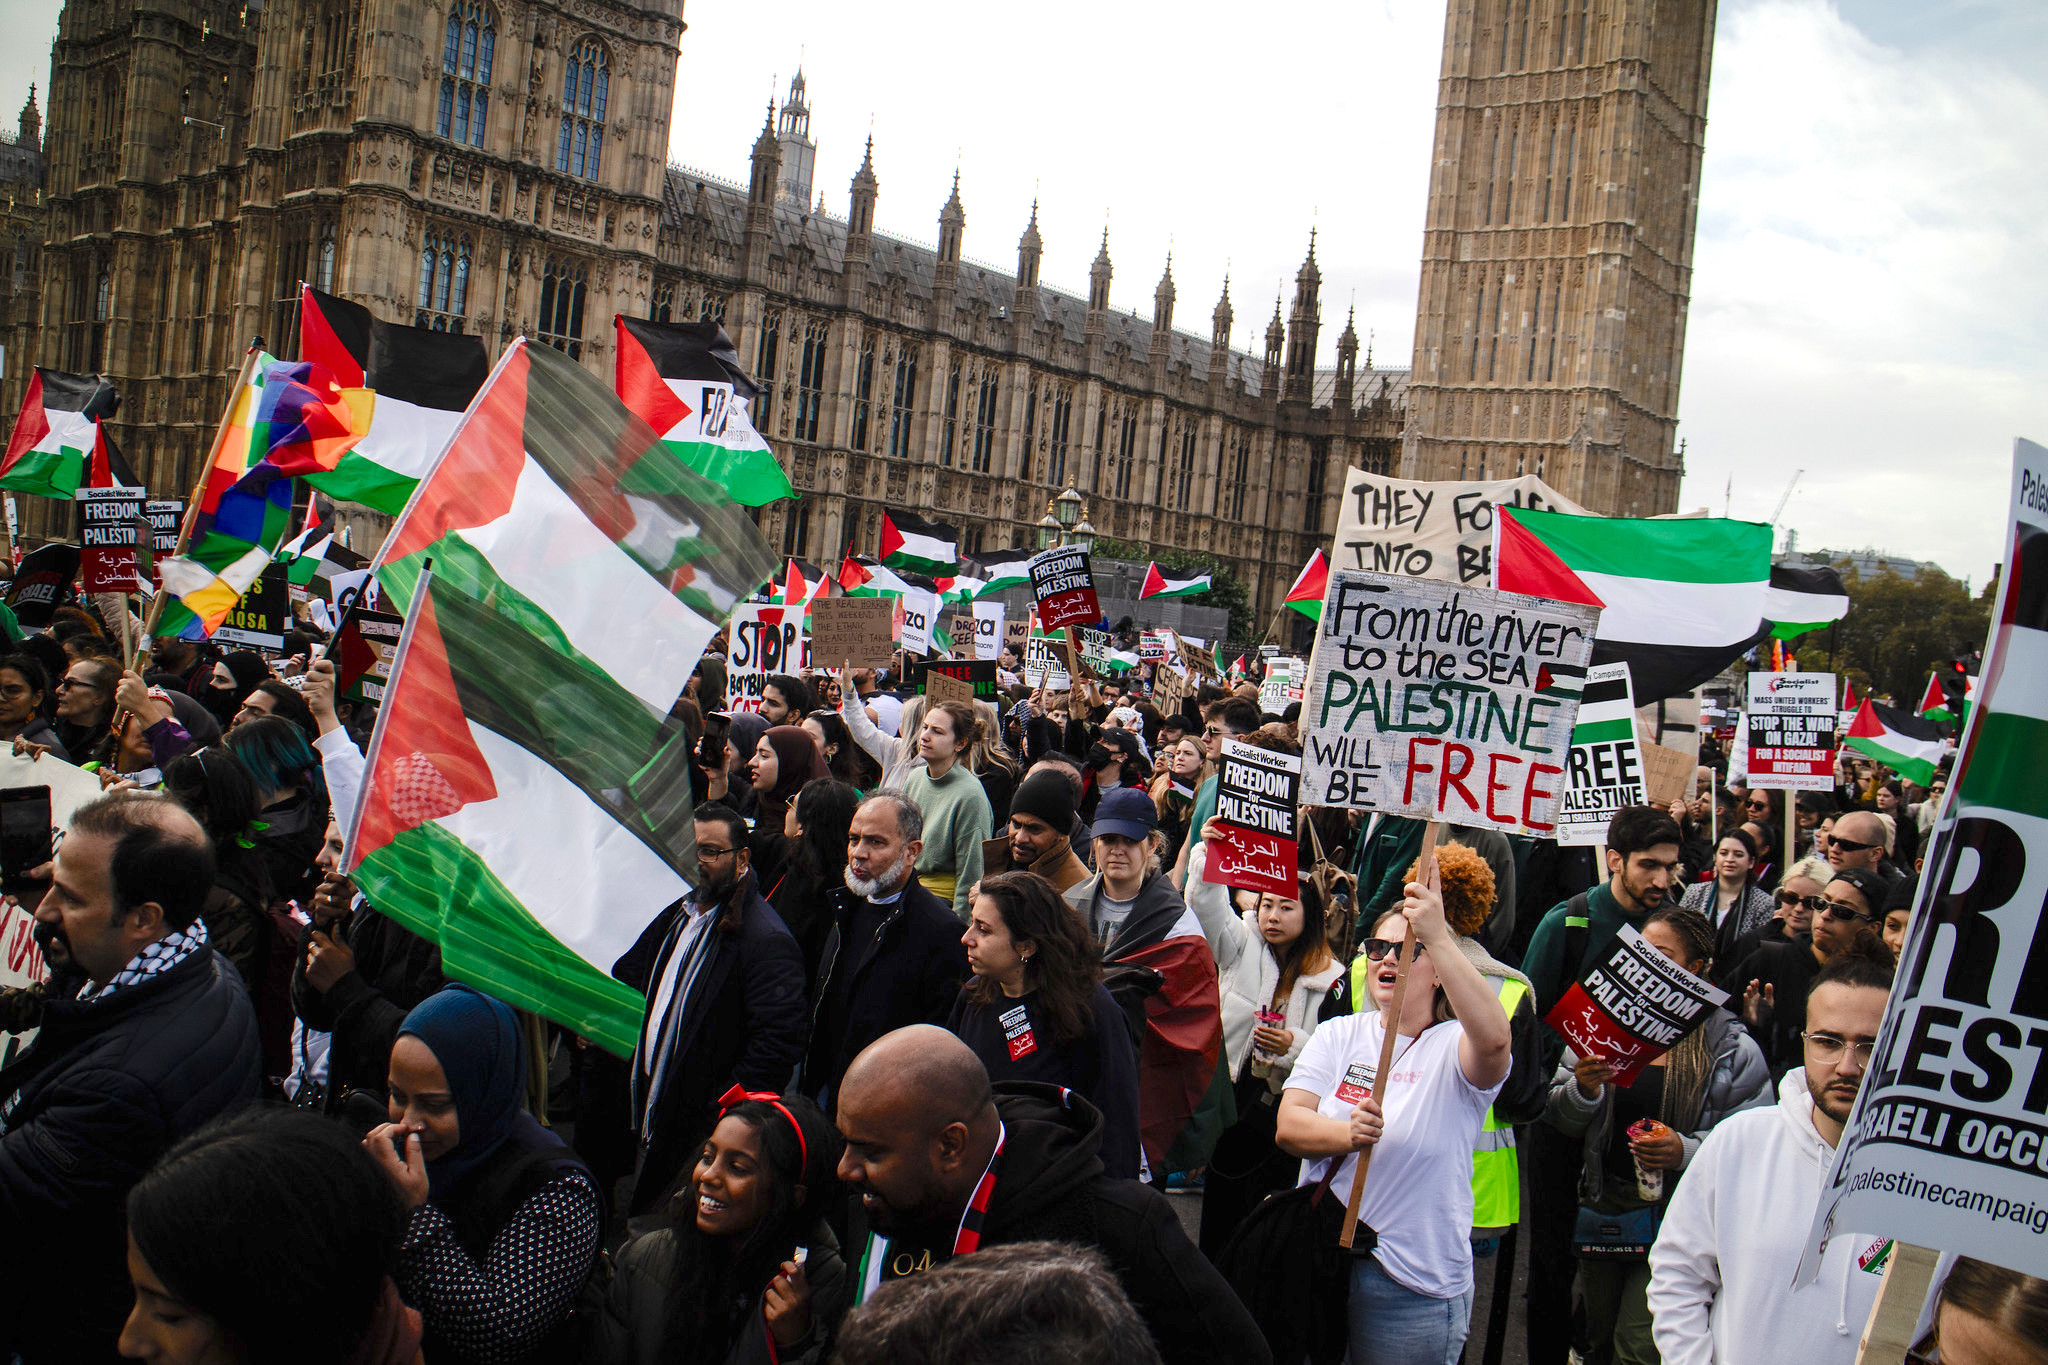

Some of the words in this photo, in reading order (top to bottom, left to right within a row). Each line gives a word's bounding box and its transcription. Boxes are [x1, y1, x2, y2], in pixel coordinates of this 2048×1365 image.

[84, 502, 141, 520] FREEDOM
[1351, 482, 1434, 534] THEY
[148, 514, 176, 528] DOM
[83, 527, 137, 545] PALESTIN
[153, 535, 179, 549] TINE
[1344, 541, 1433, 576] INTO
[1033, 555, 1084, 581] FREEDOM
[1055, 572, 1065, 580] for
[1036, 574, 1091, 601] PALESTINE
[815, 600, 832, 609] THE
[836, 600, 858, 609] REAL
[861, 600, 891, 609] HORROR
[815, 612, 833, 621] THIS
[838, 610, 875, 620] WEEKEND
[878, 609, 887, 618] IS
[905, 610, 926, 631] za
[1333, 582, 1431, 643] From
[1436, 592, 1485, 648] the
[360, 621, 387, 636] Death
[816, 622, 833, 632] THE
[836, 621, 866, 631] ETHNIC
[814, 632, 865, 643] CLEANSING
[1083, 627, 1107, 645] STOP
[732, 620, 797, 674] STOP
[814, 645, 841, 656] PLACE
[847, 644, 855, 655] IN
[1088, 644, 1105, 659] THE
[1338, 634, 1387, 670] to
[1396, 642, 1457, 681] the
[1462, 649, 1530, 688] SEA
[1593, 668, 1626, 681] Campaign
[1779, 677, 1819, 685] Socialist
[933, 677, 967, 702] FREE
[1264, 682, 1289, 697] FRE
[1754, 696, 1773, 704] MASS
[1774, 697, 1796, 705] UNITED
[1771, 705, 1803, 713] STRUGGLE
[1319, 669, 1562, 754] PALESTINE
[1750, 716, 1780, 731] STOP
[1782, 716, 1804, 731] THE
[1805, 716, 1834, 732] WAR
[1765, 731, 1782, 746] ON
[1783, 731, 1818, 746] GAZA!
[1312, 735, 1382, 770] WILL
[1755, 748, 1774, 760] FOR
[1774, 749, 1782, 760] A
[1782, 749, 1828, 761] SOCIALIST
[1569, 741, 1641, 789] REE
[1772, 761, 1812, 774] INTIFADA
[1223, 760, 1291, 800] FREEDOM
[1325, 769, 1378, 807] BE
[1402, 737, 1566, 832] FREE
[1248, 790, 1261, 804] for
[1564, 785, 1644, 811] ALESTINE
[1217, 794, 1293, 836] PALESTINE
[1571, 811, 1597, 823] ISRAELI
[1598, 810, 1616, 822] OCC
[1228, 830, 1279, 857] الحرية
[1218, 854, 1287, 881] لفلسطين
[1607, 947, 1703, 1021] FREEDOM
[1583, 968, 1684, 1046] PALESTINE
[1633, 993, 1651, 1009] for
[1002, 1011, 1027, 1030] FREEDOM
[1005, 1021, 1032, 1041] PALESTINE
[1581, 1005, 1643, 1057] الحرية
